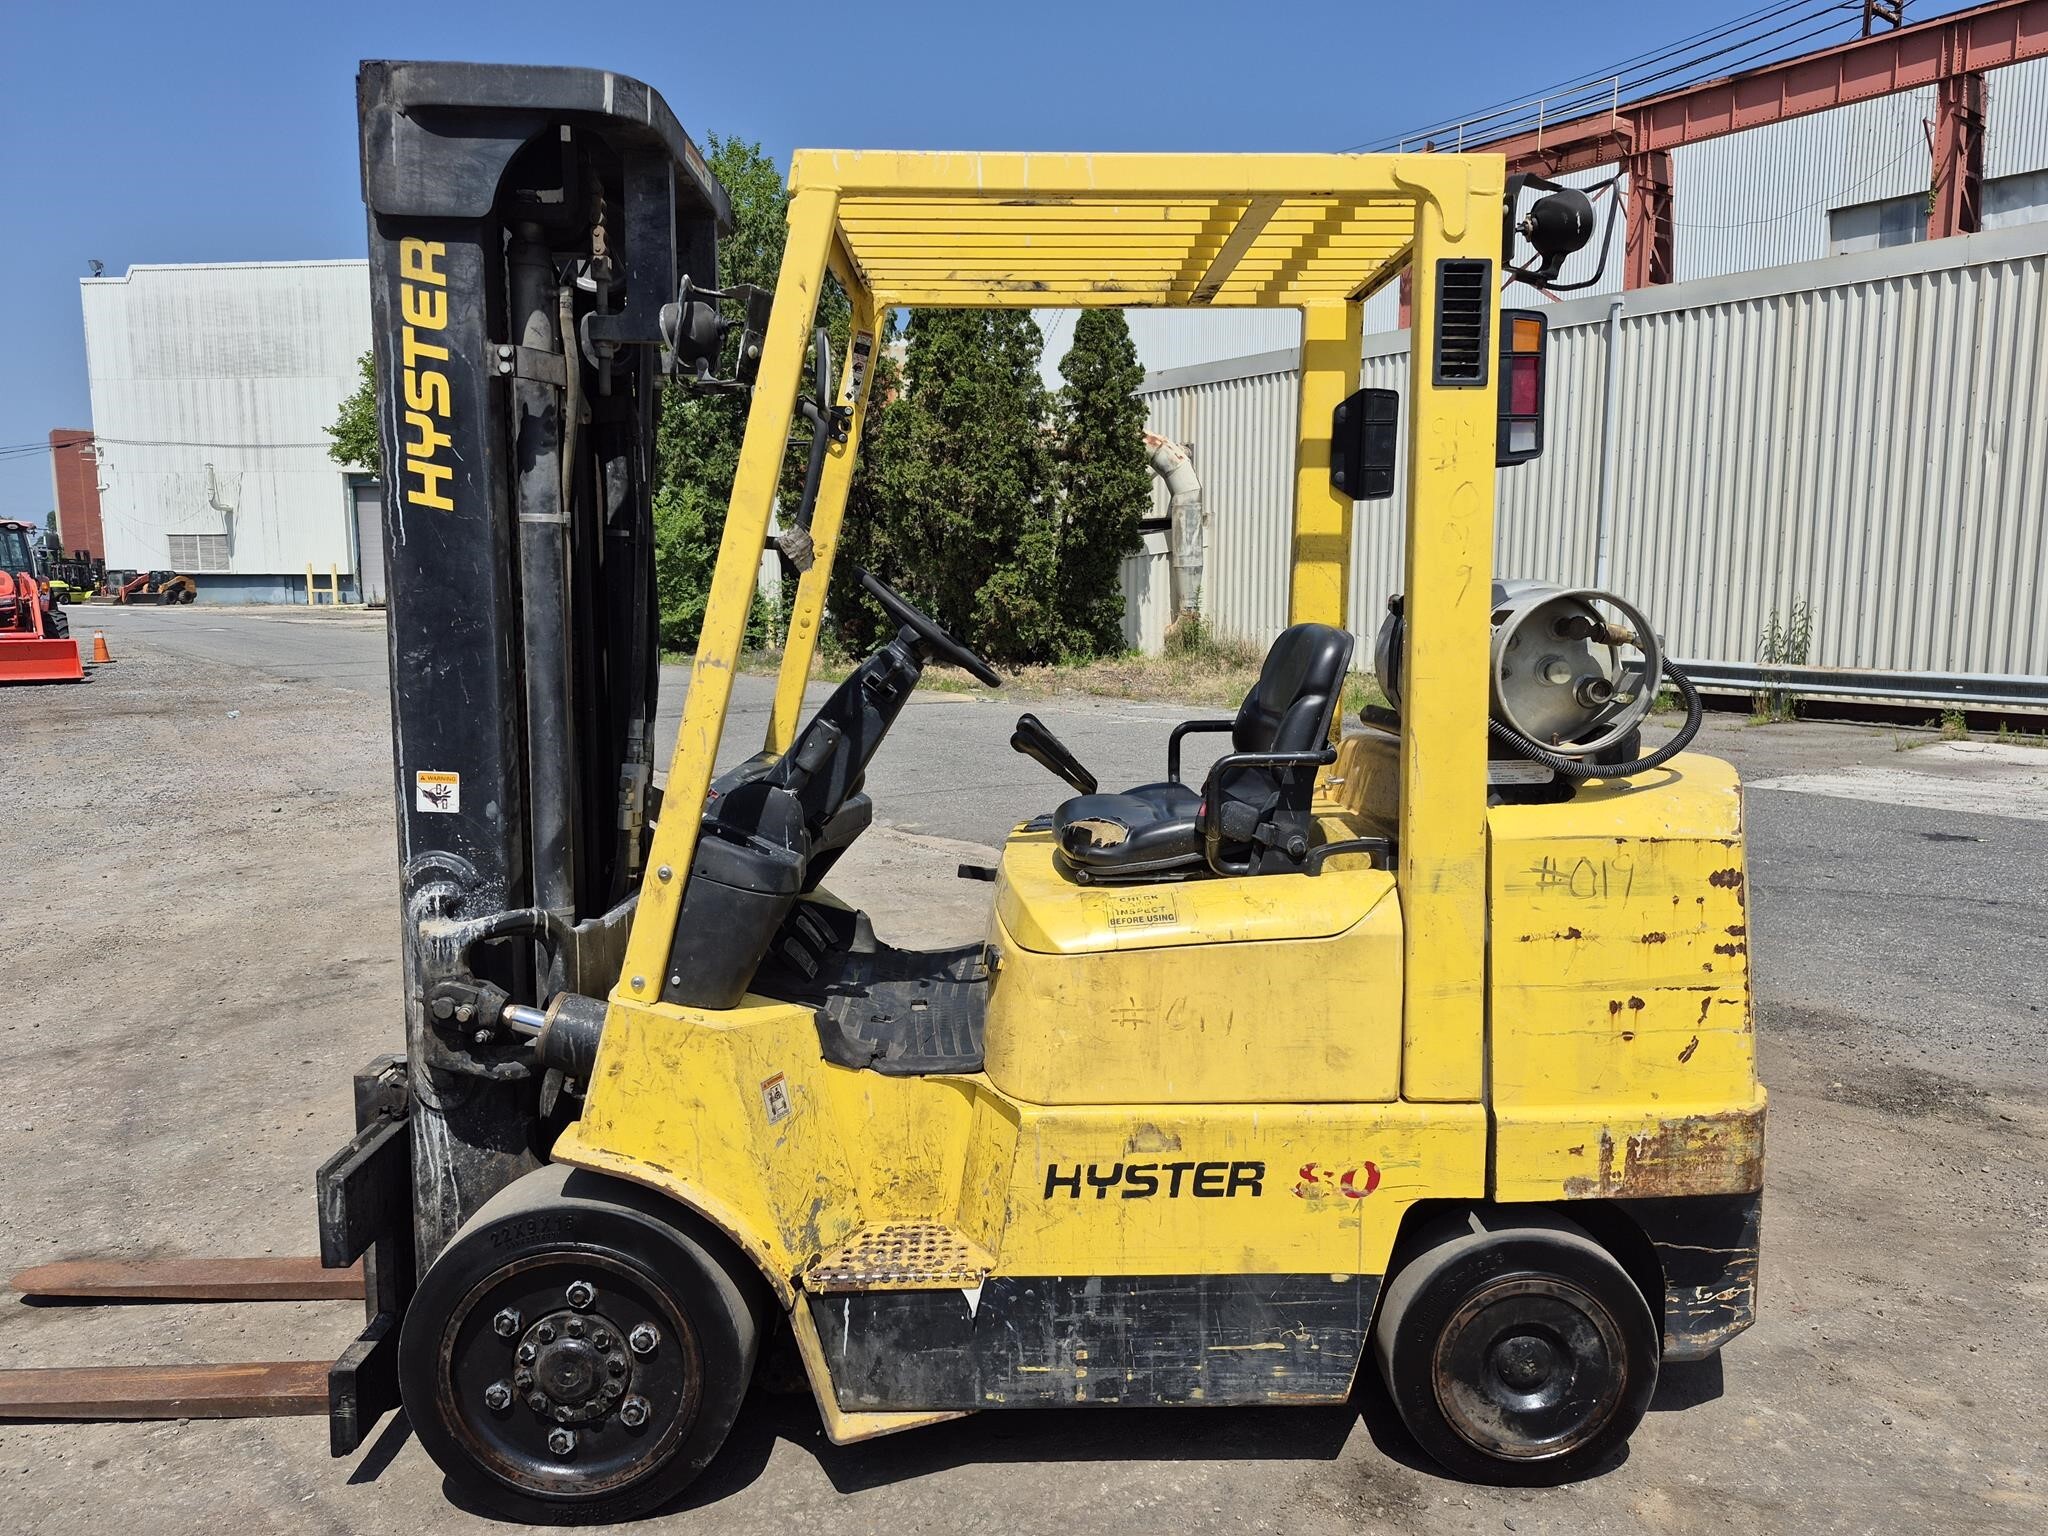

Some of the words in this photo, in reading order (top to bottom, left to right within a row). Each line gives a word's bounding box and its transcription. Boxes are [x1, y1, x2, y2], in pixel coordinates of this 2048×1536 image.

[400, 236, 454, 511] HYSTER
[1110, 916, 1145, 926] BEFORE
[1147, 913, 1175, 923] USING
[1115, 906, 1166, 916] INSPECT
[1043, 1160, 1266, 1200] HYSTER
